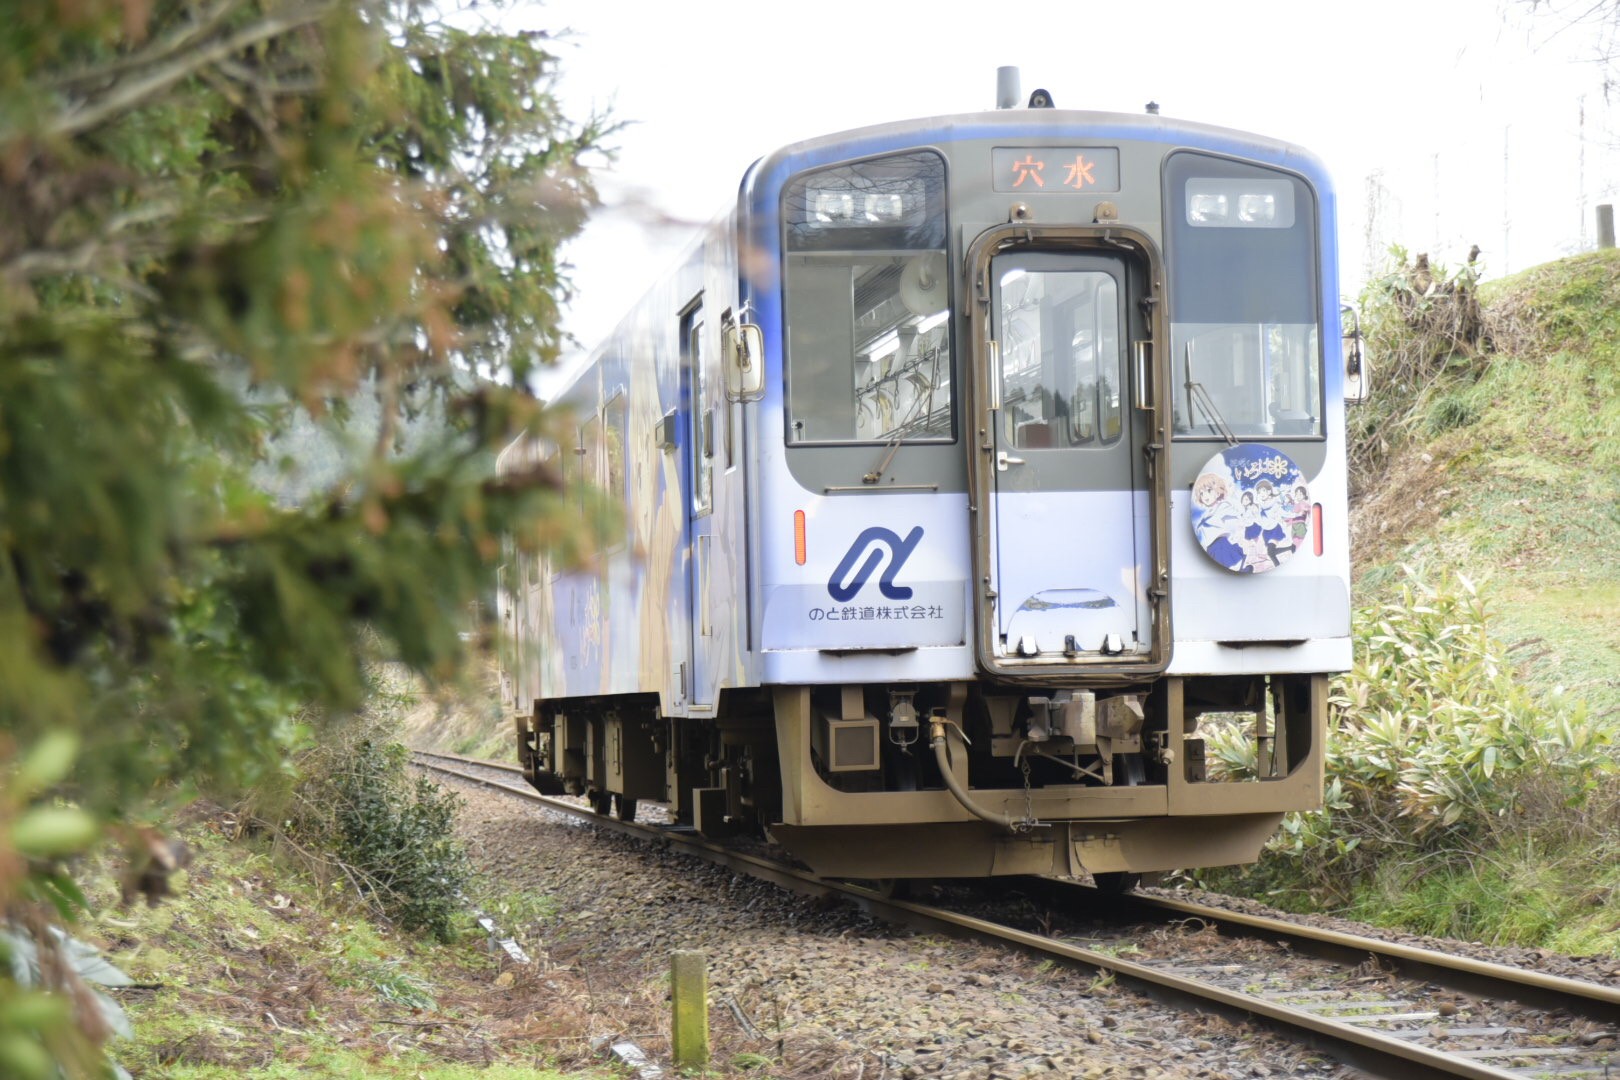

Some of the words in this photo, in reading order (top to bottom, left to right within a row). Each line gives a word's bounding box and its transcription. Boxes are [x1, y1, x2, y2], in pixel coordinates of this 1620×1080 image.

[1011, 154, 1096, 189] 穴水
[808, 605, 944, 621] のと鉄道株式会社
